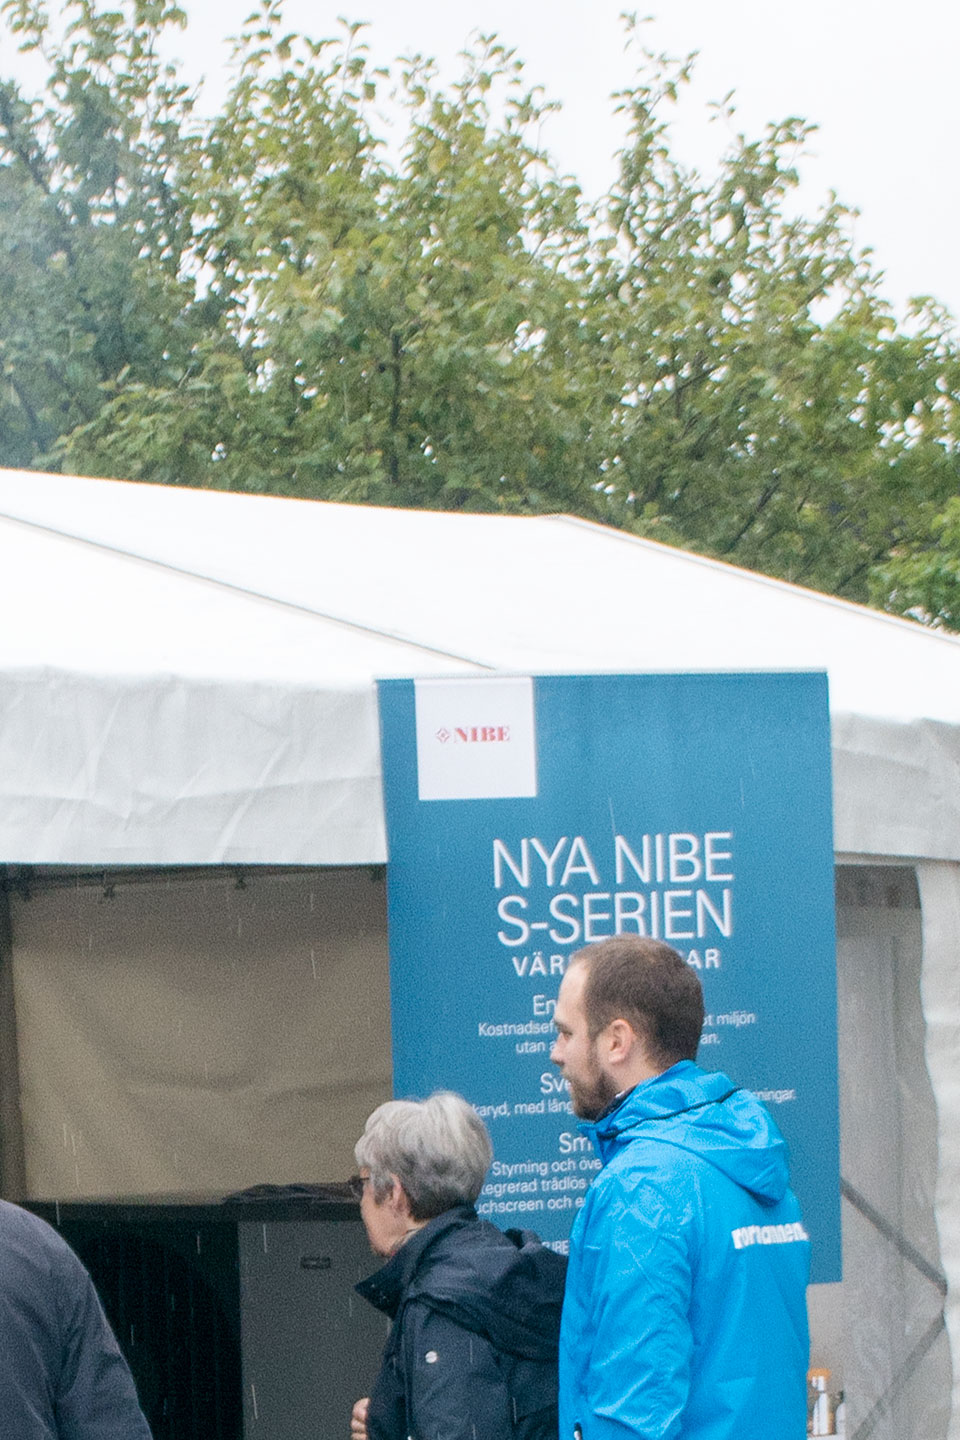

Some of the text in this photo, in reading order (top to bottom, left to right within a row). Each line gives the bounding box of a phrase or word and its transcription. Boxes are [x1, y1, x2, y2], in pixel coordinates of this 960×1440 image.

[453, 725, 510, 743] NIBE
[492, 831, 735, 889] NYA NIBE
[496, 888, 734, 947] S-SERIEN
[716, 1010, 757, 1028] miljön
[515, 1041, 546, 1053] utan
[514, 1100, 545, 1115] med
[492, 1160, 548, 1178] Styrning
[551, 1158, 575, 1173] och
[541, 1177, 586, 1192] trådlös
[547, 1196, 572, 1210] och
